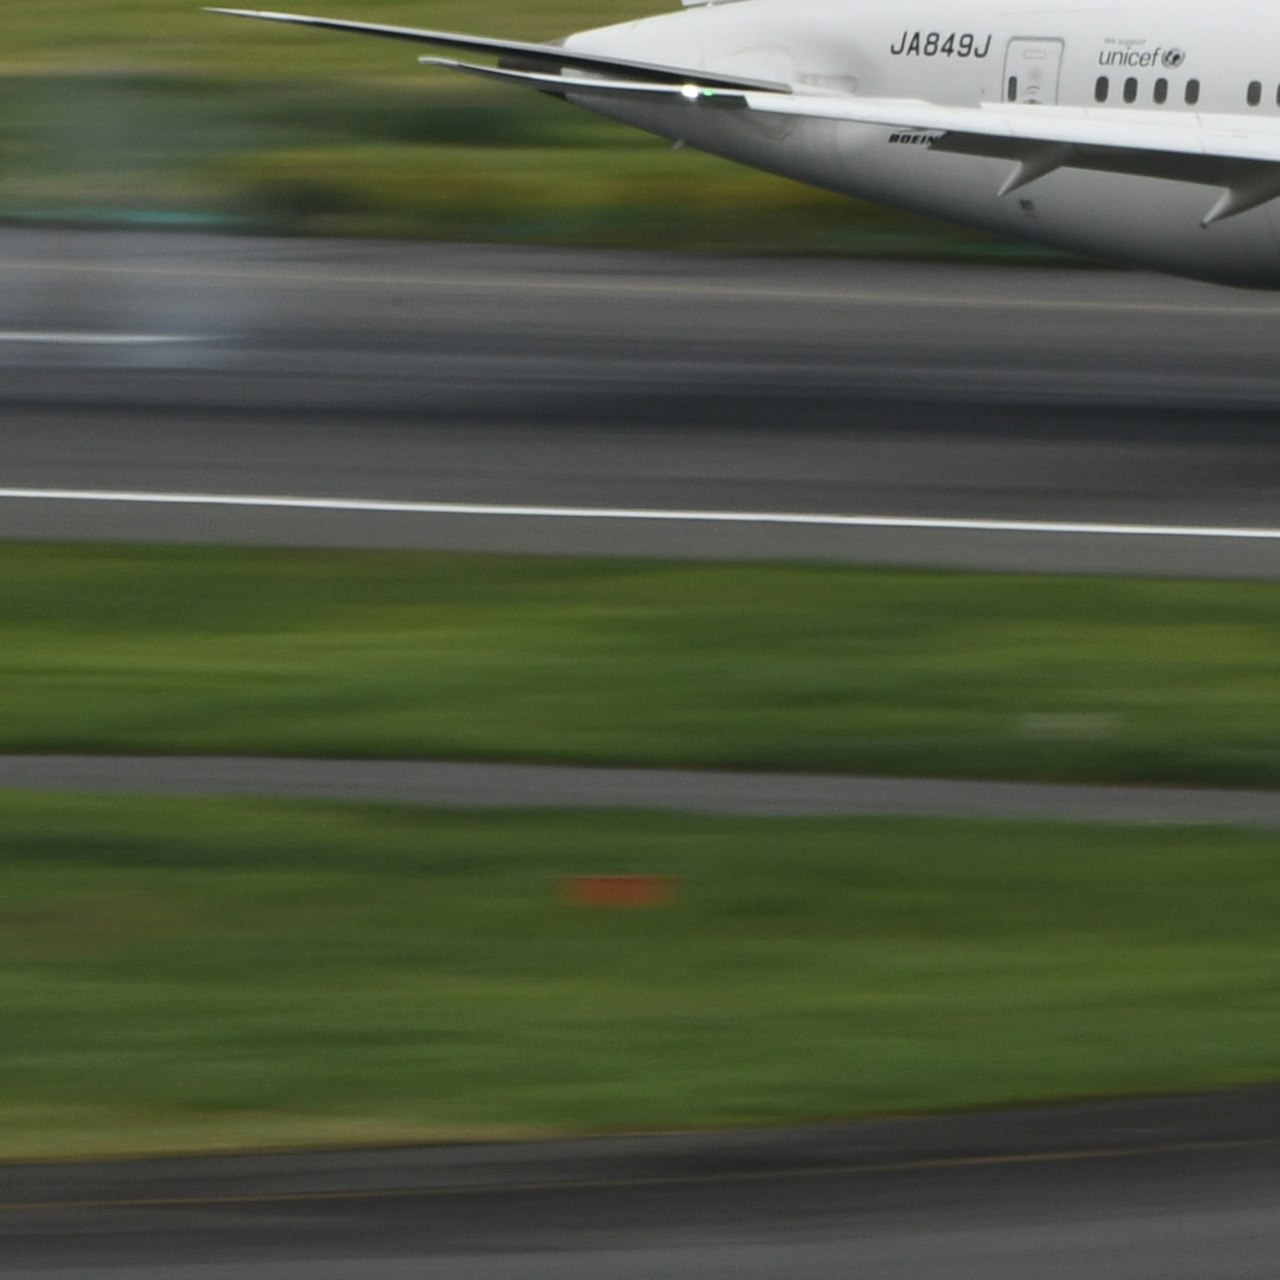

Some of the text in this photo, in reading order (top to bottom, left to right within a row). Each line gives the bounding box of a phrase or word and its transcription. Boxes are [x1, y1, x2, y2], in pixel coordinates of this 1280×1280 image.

[890, 31, 992, 58] JA849J
[1098, 47, 1161, 67] unicef
[888, 133, 936, 145] BOEIN
